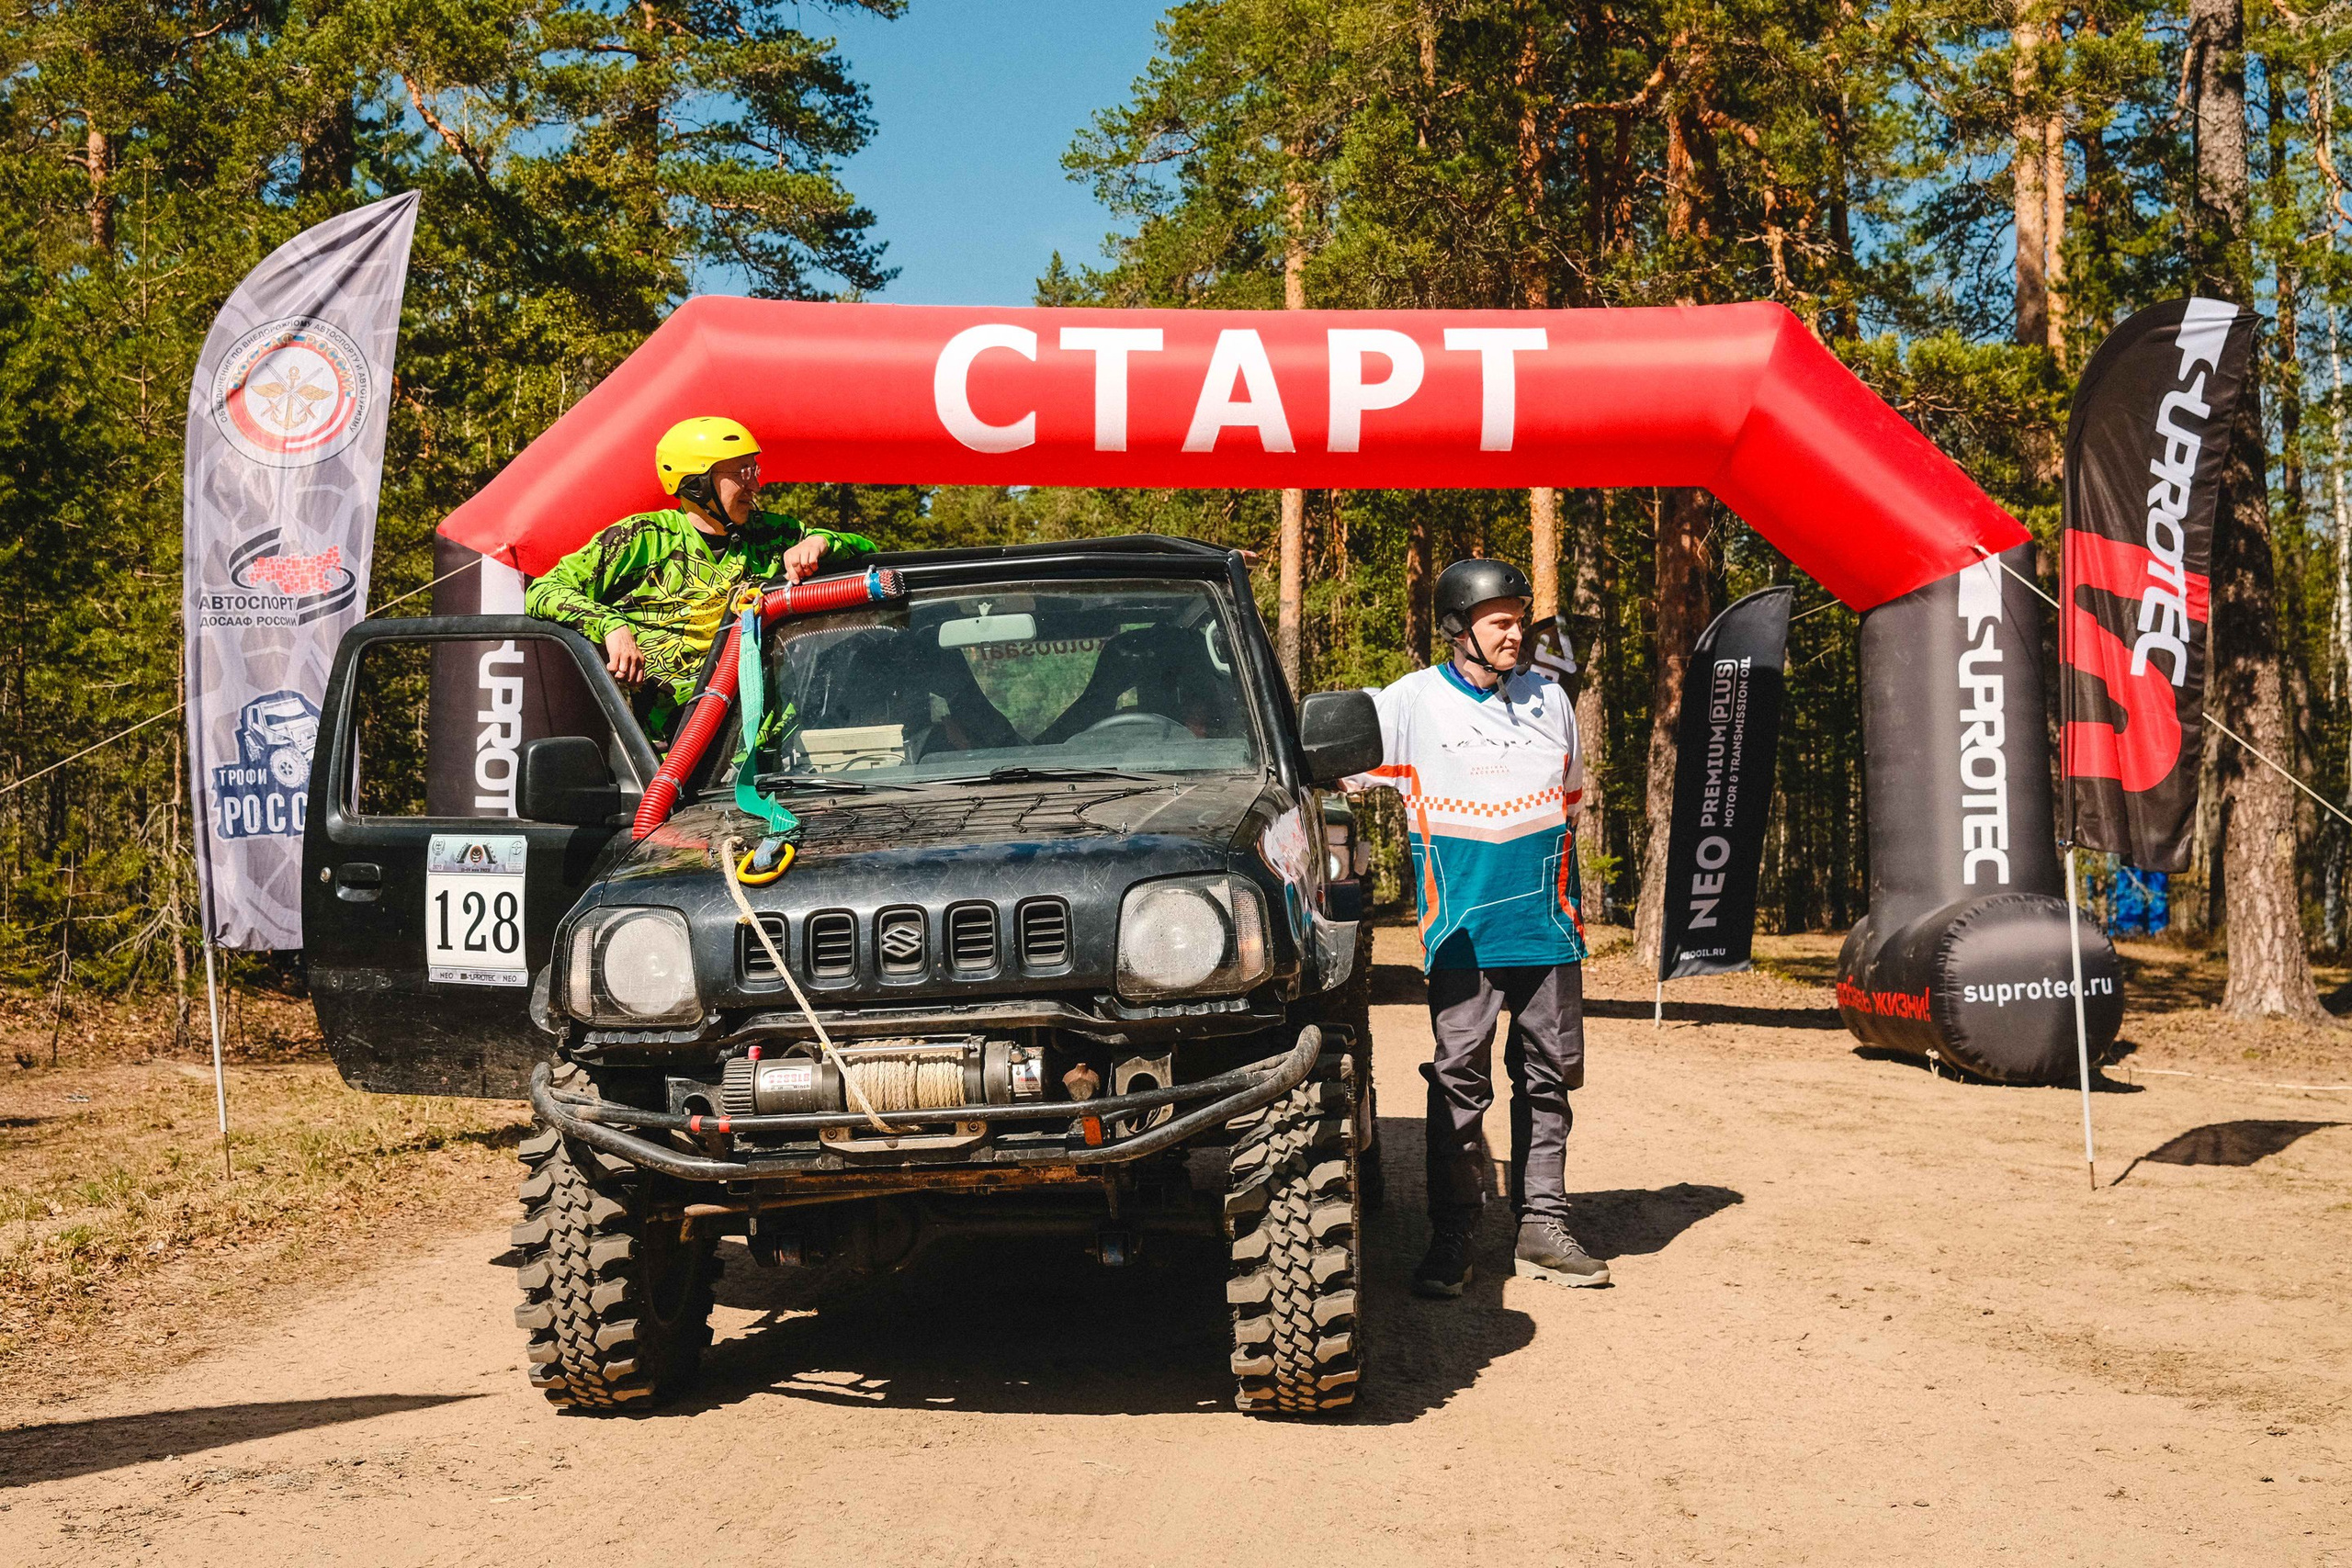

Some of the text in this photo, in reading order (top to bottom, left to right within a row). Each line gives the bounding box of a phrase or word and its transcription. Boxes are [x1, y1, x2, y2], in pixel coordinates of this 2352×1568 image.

[232, 346, 243, 359] ПО
[314, 323, 360, 364] АВТОСПОРТУ
[232, 333, 355, 394] ДОСААФ РОССИИ
[933, 324, 1548, 454] СТАРТ
[2131, 300, 2236, 687] SUPROTEC
[198, 596, 294, 611] АВТОСПОРТ
[200, 615, 298, 627] ДОСААФ РОССИИ
[1740, 656, 1751, 677] OIL
[1730, 680, 1749, 773] TRANSMISSION
[1958, 555, 2009, 885] SUPROTEC
[219, 769, 267, 786] ТРОФИ
[1688, 663, 1734, 929] NEO PREMIUM PLUS
[224, 792, 309, 836] РОСС
[1724, 785, 1737, 827] MOTOR
[435, 889, 520, 953] 128
[439, 972, 454, 980] NEO
[503, 975, 517, 983] NEO
